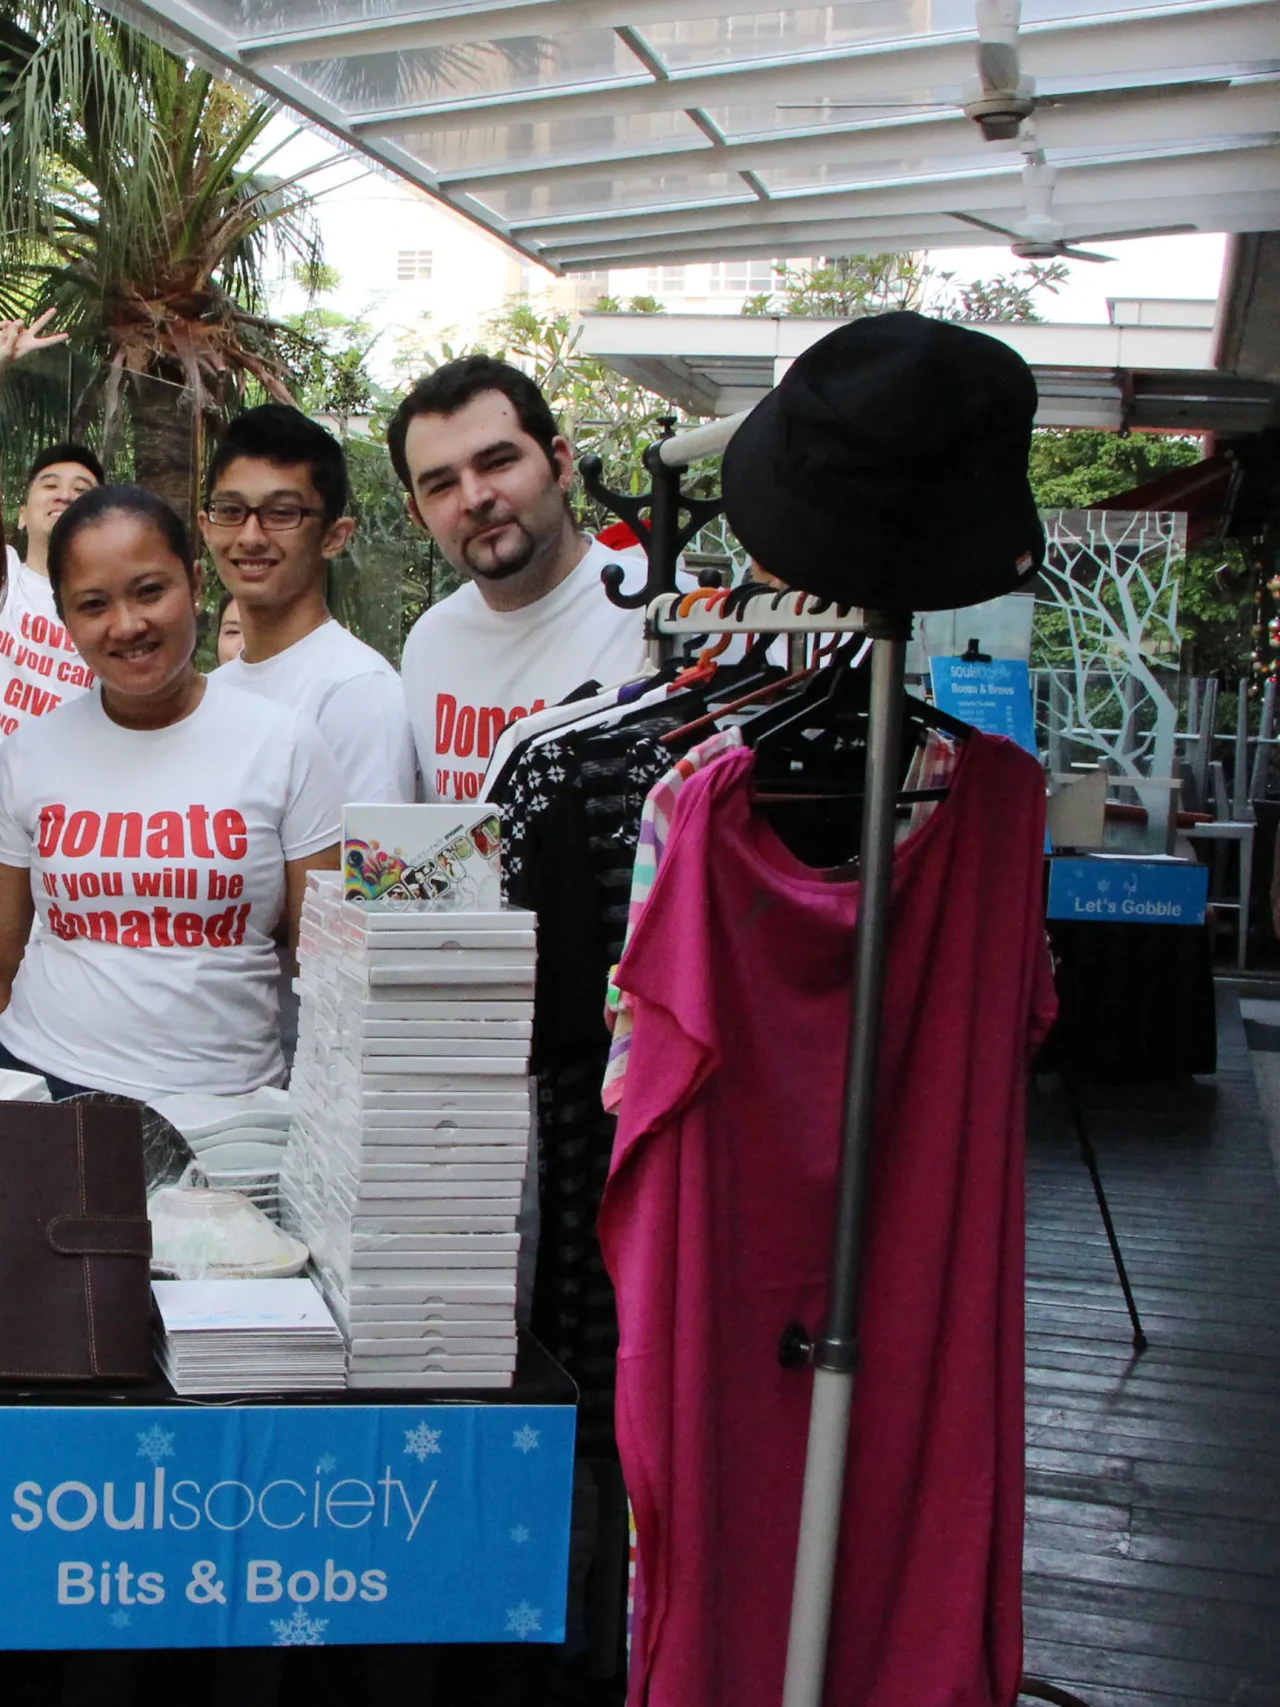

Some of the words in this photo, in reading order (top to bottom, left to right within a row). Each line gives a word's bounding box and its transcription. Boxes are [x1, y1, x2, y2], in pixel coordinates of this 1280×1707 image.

[14, 644, 54, 678] you
[435, 768, 450, 796] or
[37, 803, 249, 861] Donate
[42, 871, 59, 899] or
[61, 871, 124, 902] you
[131, 867, 198, 900] will
[207, 868, 244, 901] be
[1073, 896, 1118, 915] Let's
[1121, 899, 1183, 918] Gobble
[10, 1465, 438, 1543] soulsociety
[57, 1560, 166, 1606] Bits
[185, 1559, 228, 1605] &
[245, 1558, 388, 1603] Bobs
